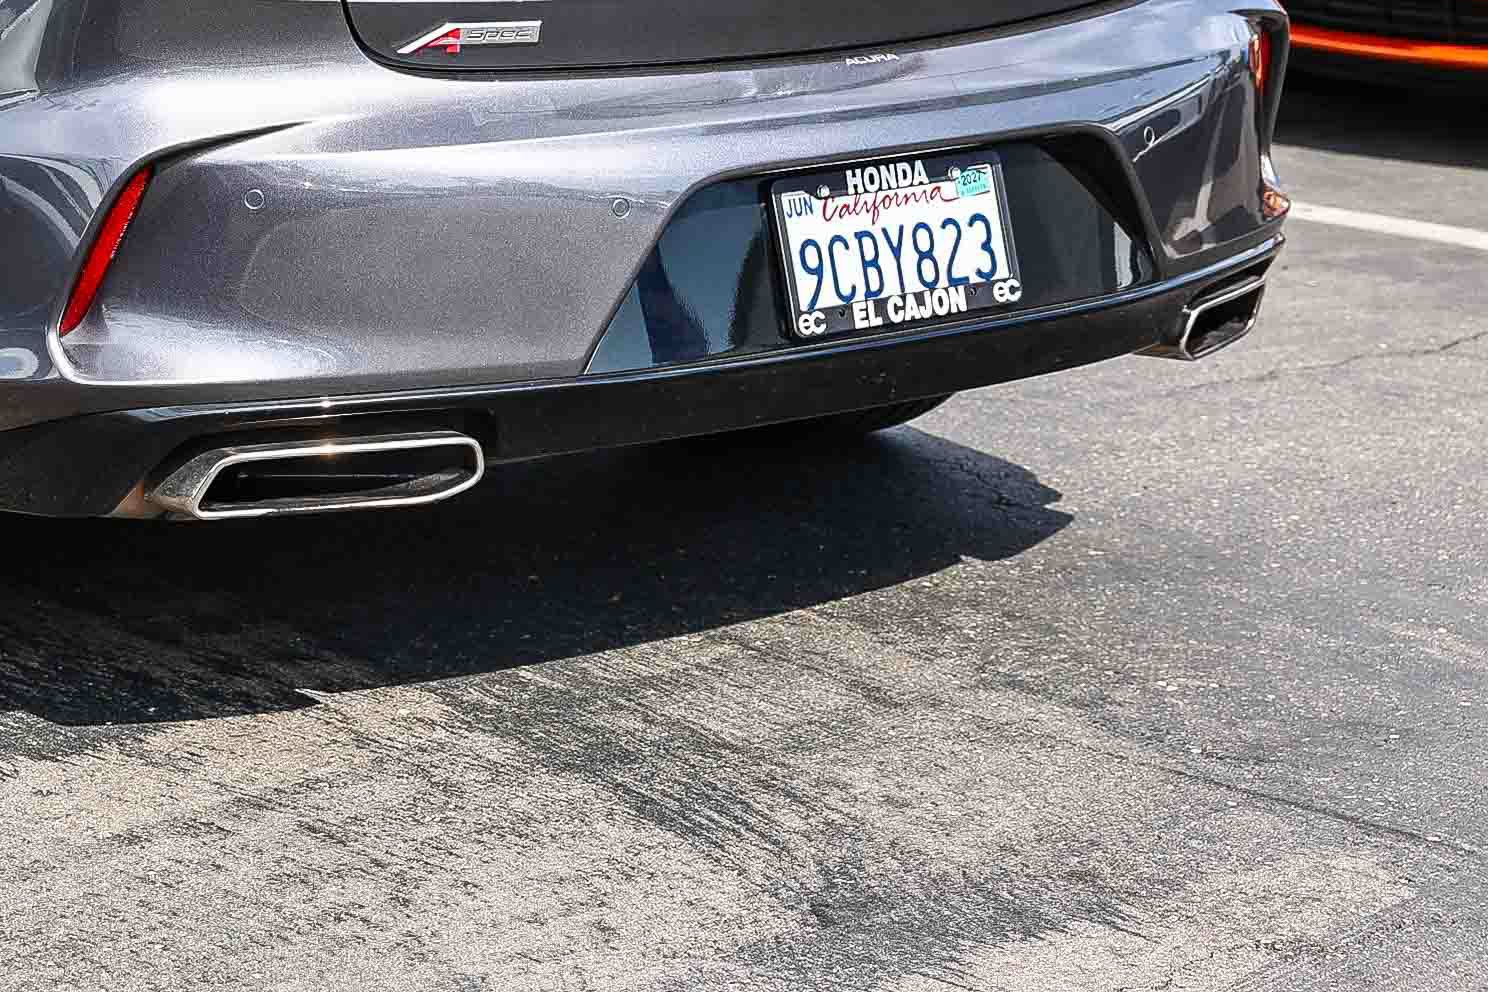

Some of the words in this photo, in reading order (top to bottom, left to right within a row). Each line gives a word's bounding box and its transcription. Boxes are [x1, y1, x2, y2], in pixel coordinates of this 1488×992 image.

[844, 53, 900, 66] ACURA
[845, 160, 930, 195] HONDA
[785, 197, 814, 219] JUN
[821, 184, 960, 226] California
[798, 212, 998, 313] 9CBY823
[852, 299, 883, 330] EL
[886, 285, 969, 323] CAJON
